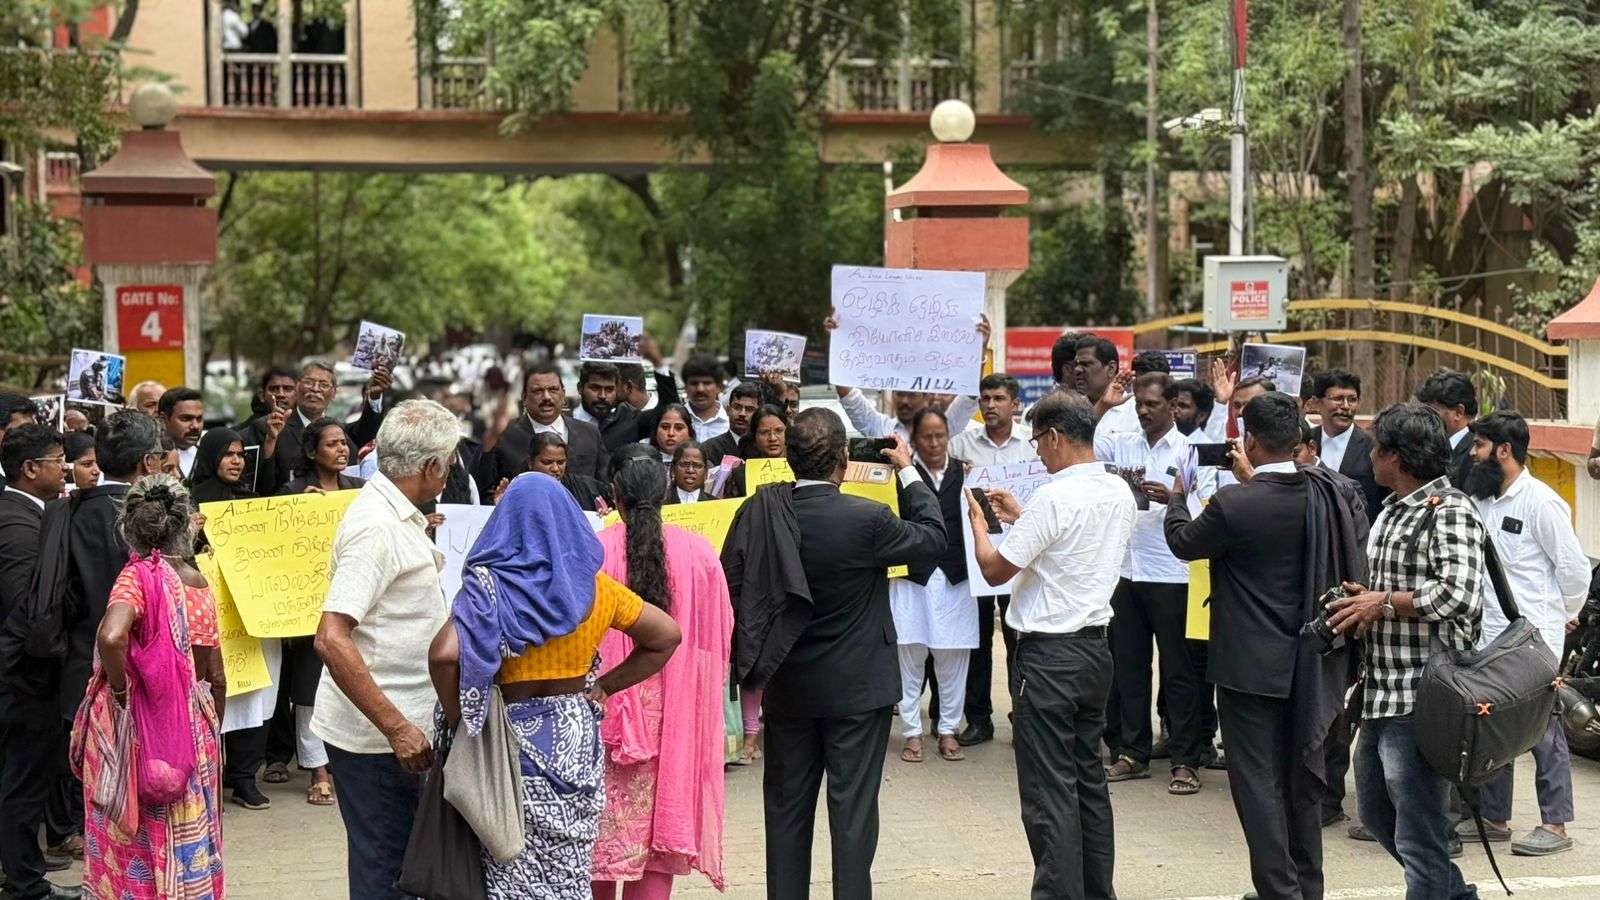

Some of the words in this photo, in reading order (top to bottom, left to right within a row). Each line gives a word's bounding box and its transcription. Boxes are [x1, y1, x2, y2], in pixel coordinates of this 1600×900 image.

[121, 291, 154, 306] GATE
[157, 291, 179, 305] No:
[1231, 295, 1267, 303] POLICE
[140, 310, 163, 343] 4
